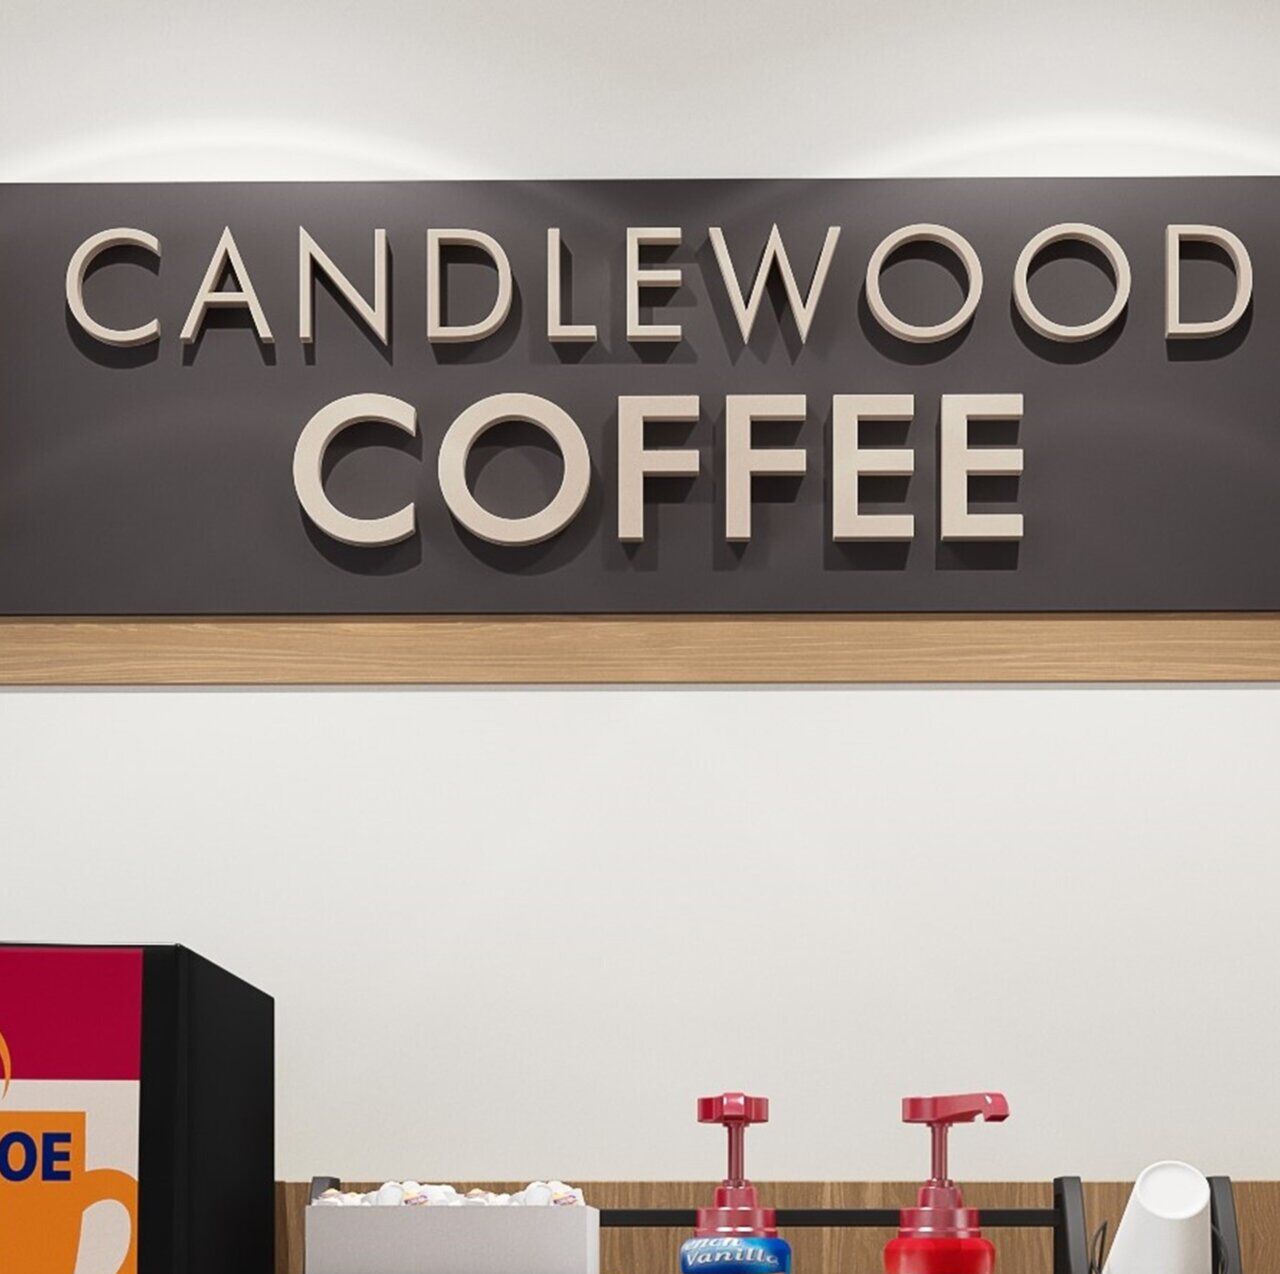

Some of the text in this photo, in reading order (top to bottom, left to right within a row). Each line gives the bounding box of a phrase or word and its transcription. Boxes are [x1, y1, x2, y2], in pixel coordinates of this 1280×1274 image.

[65, 221, 1255, 346] CANDLEWOOD
[292, 391, 1026, 546] COFFEE
[686, 1248, 779, 1266] Vanilla
